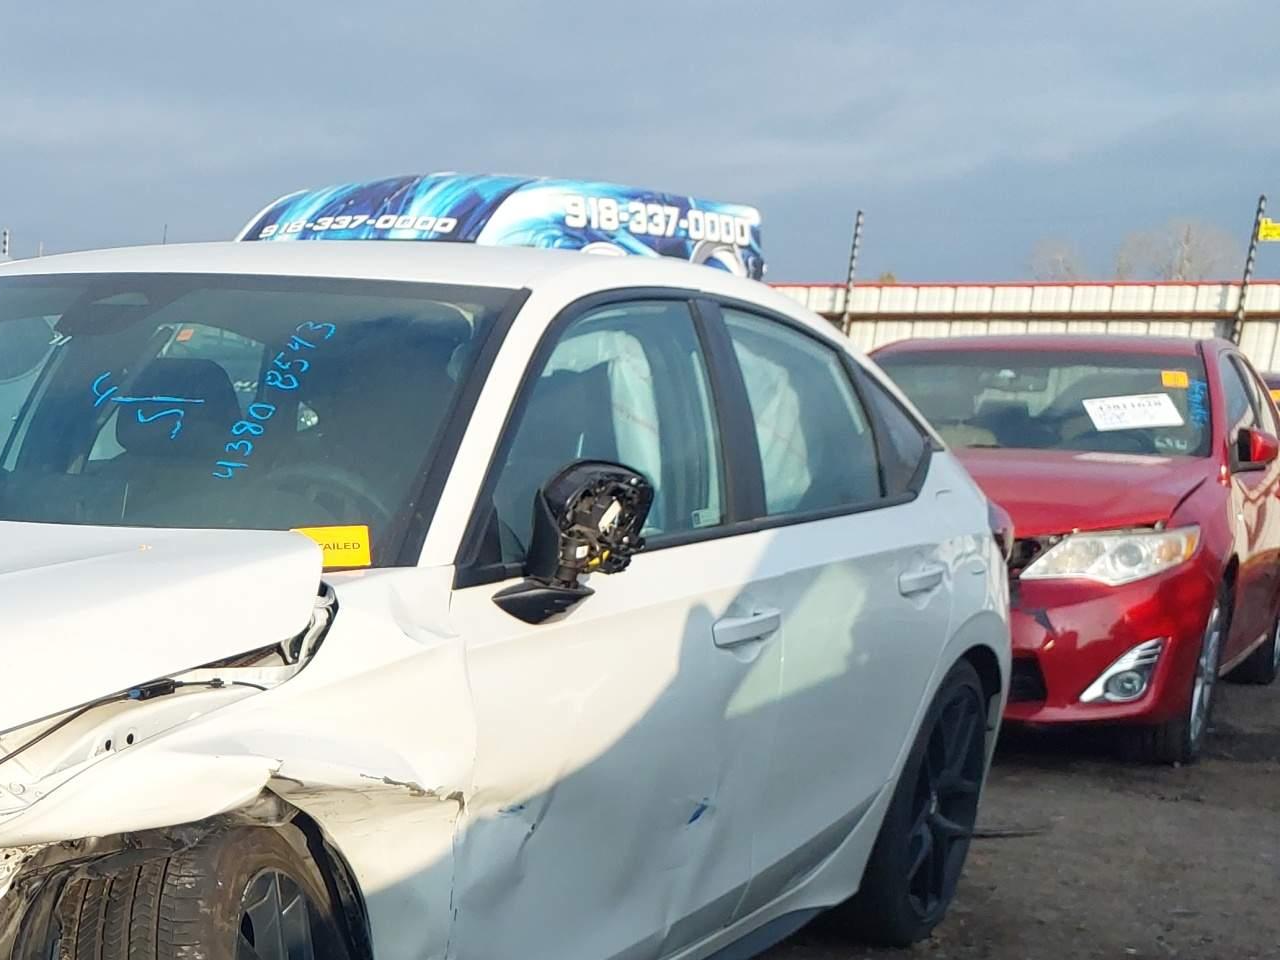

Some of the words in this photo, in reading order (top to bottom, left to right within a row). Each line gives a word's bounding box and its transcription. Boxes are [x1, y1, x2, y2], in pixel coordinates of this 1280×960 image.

[259, 214, 458, 238] 918-337-0000
[565, 196, 753, 246] 918-337-0000
[319, 542, 361, 551] AILED
